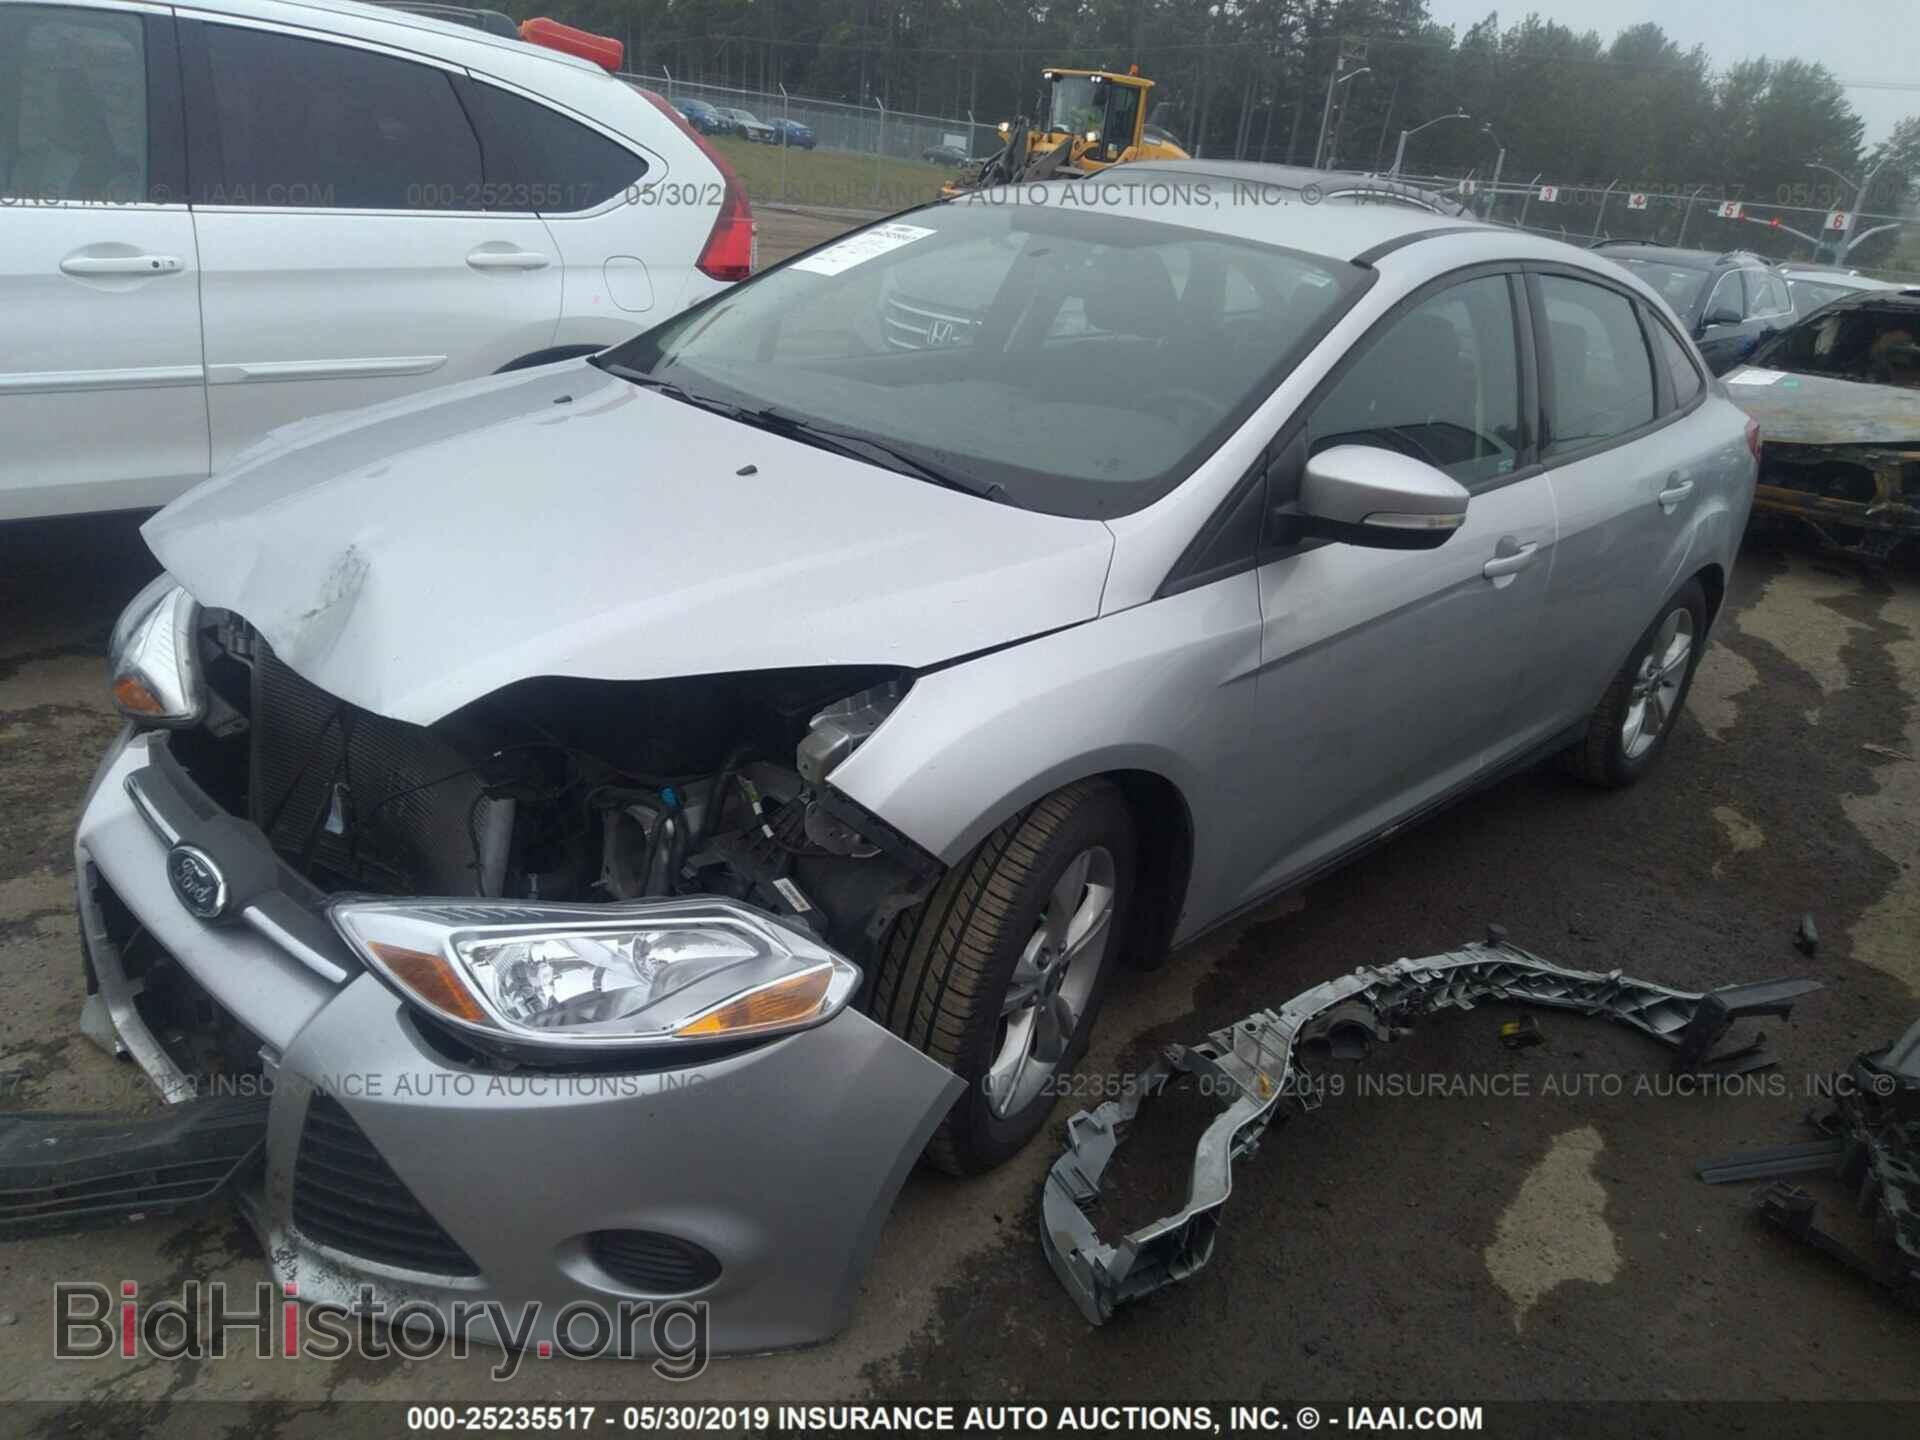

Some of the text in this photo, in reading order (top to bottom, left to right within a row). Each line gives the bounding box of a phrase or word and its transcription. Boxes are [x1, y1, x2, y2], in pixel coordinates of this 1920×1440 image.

[1543, 186, 1553, 200] 3
[1724, 202, 1737, 217] 5
[1833, 213, 1845, 229] 6
